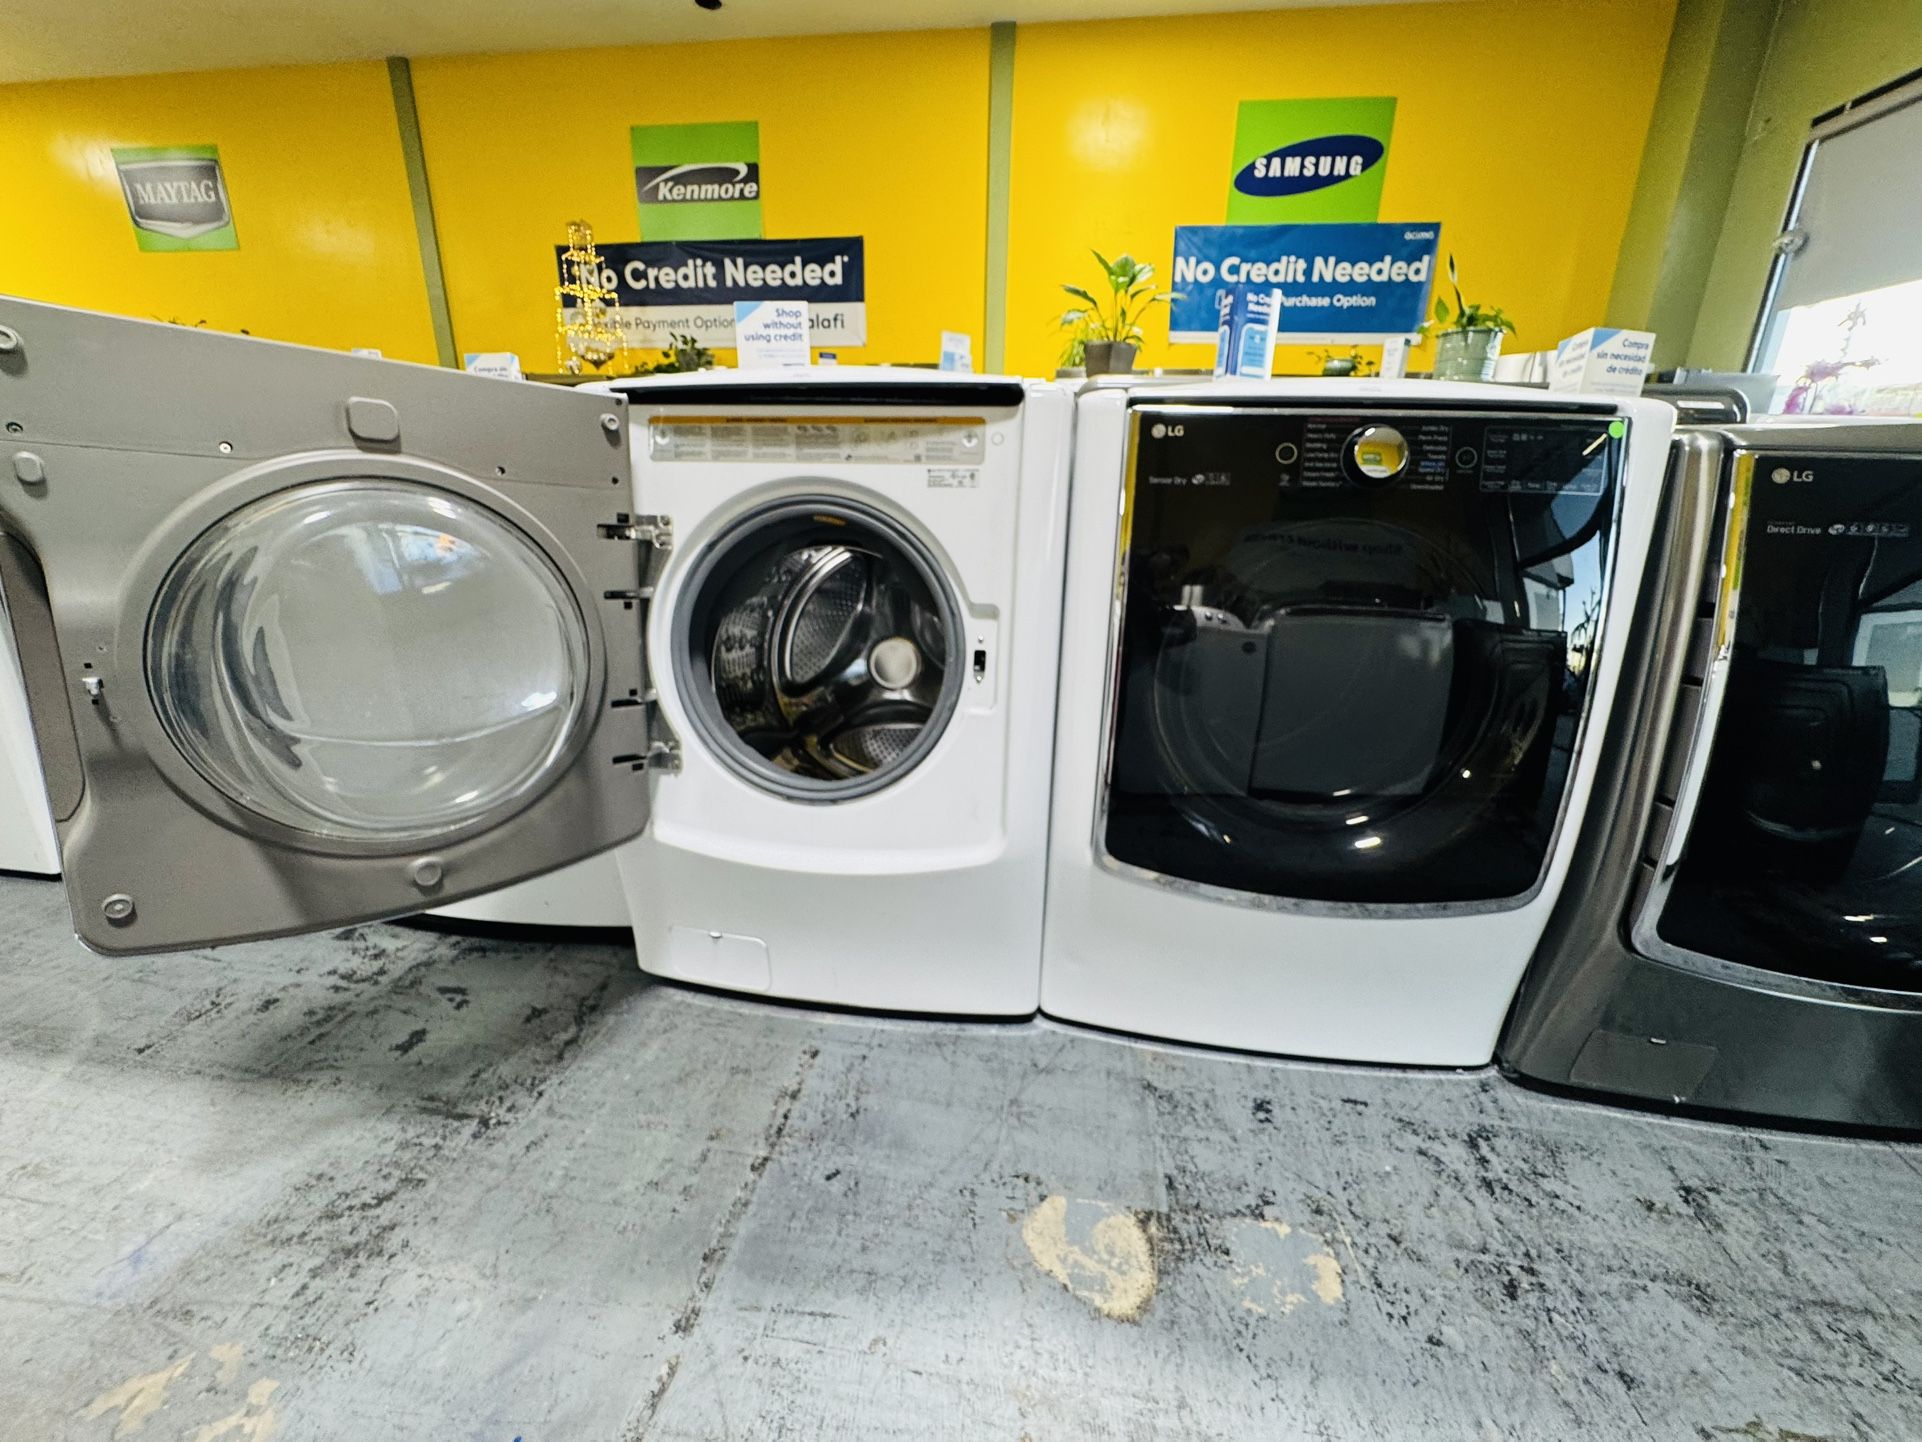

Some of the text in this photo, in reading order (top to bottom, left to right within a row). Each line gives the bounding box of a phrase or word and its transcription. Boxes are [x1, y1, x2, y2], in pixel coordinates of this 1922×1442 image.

[1253, 155, 1363, 178] SAMSUNG
[133, 180, 216, 205] MAYTAG
[658, 180, 758, 201] Kenmore
[579, 262, 618, 291] No
[624, 258, 717, 290] Credit
[1173, 254, 1431, 284] No Credit Needed
[1332, 293, 1376, 309] Option
[775, 308, 802, 318] Shop
[808, 313, 845, 329] alafi
[634, 317, 690, 331] Payment
[763, 321, 803, 330] without
[744, 332, 804, 343] using credit
[1167, 425, 1184, 437] LG
[1793, 470, 1814, 482] LG
